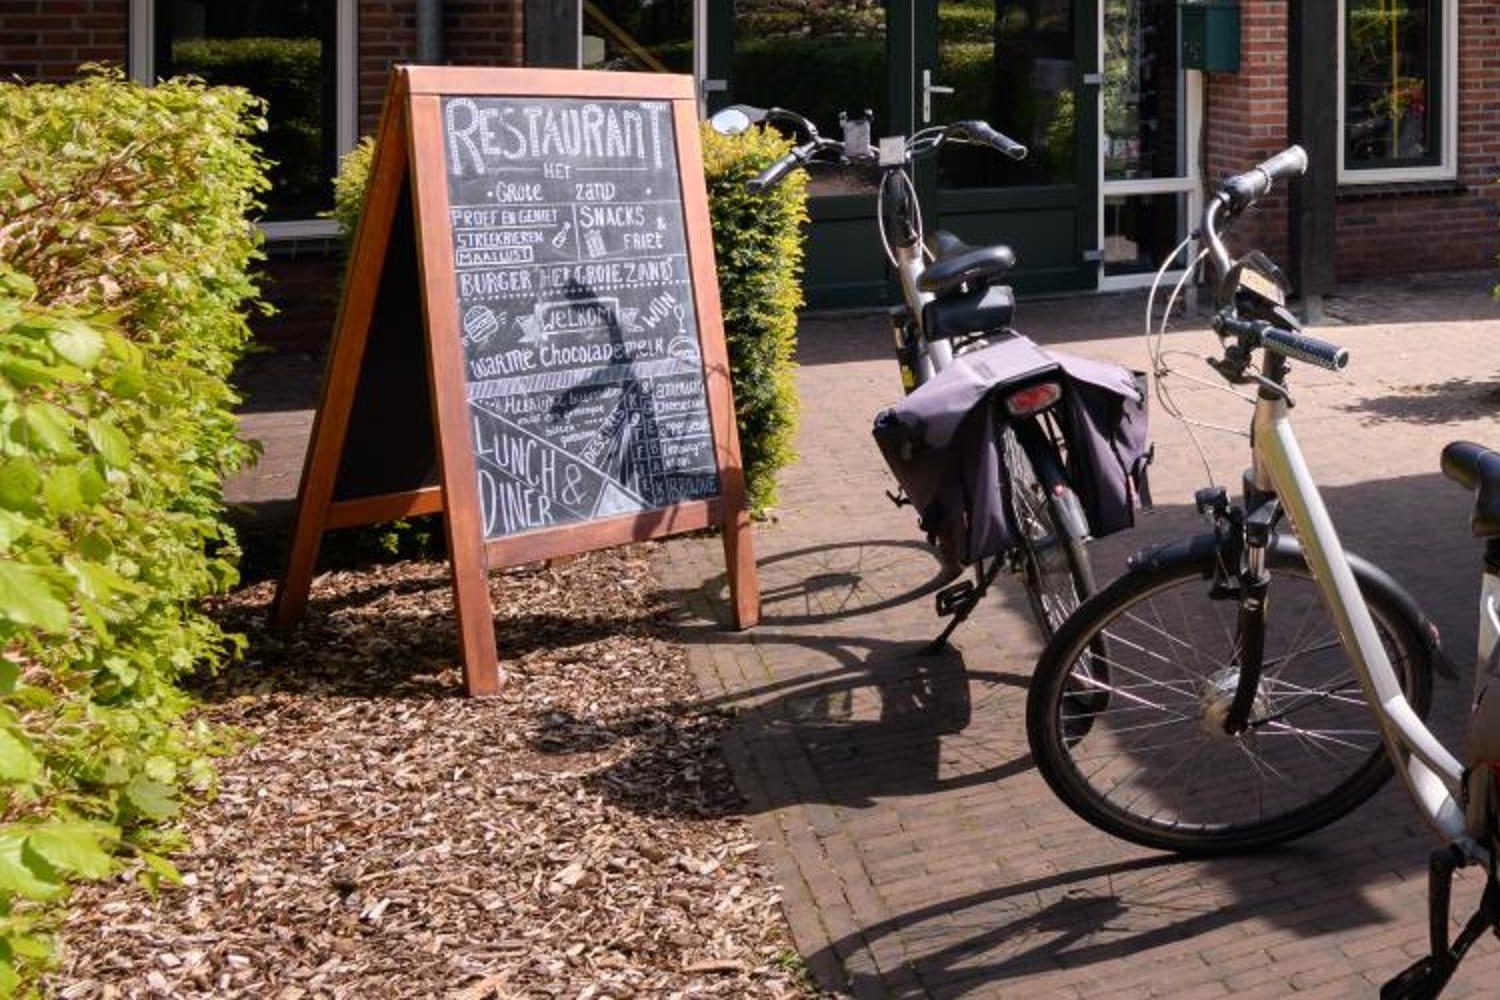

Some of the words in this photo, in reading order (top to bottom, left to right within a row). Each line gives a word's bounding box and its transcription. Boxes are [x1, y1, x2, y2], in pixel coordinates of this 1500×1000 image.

[446, 98, 669, 175] RESTAURANT
[580, 205, 646, 228] SNACKS
[460, 269, 532, 297] BURGER
[474, 416, 557, 501] LUNCH
[562, 463, 587, 505] &
[478, 469, 555, 537] DINER
